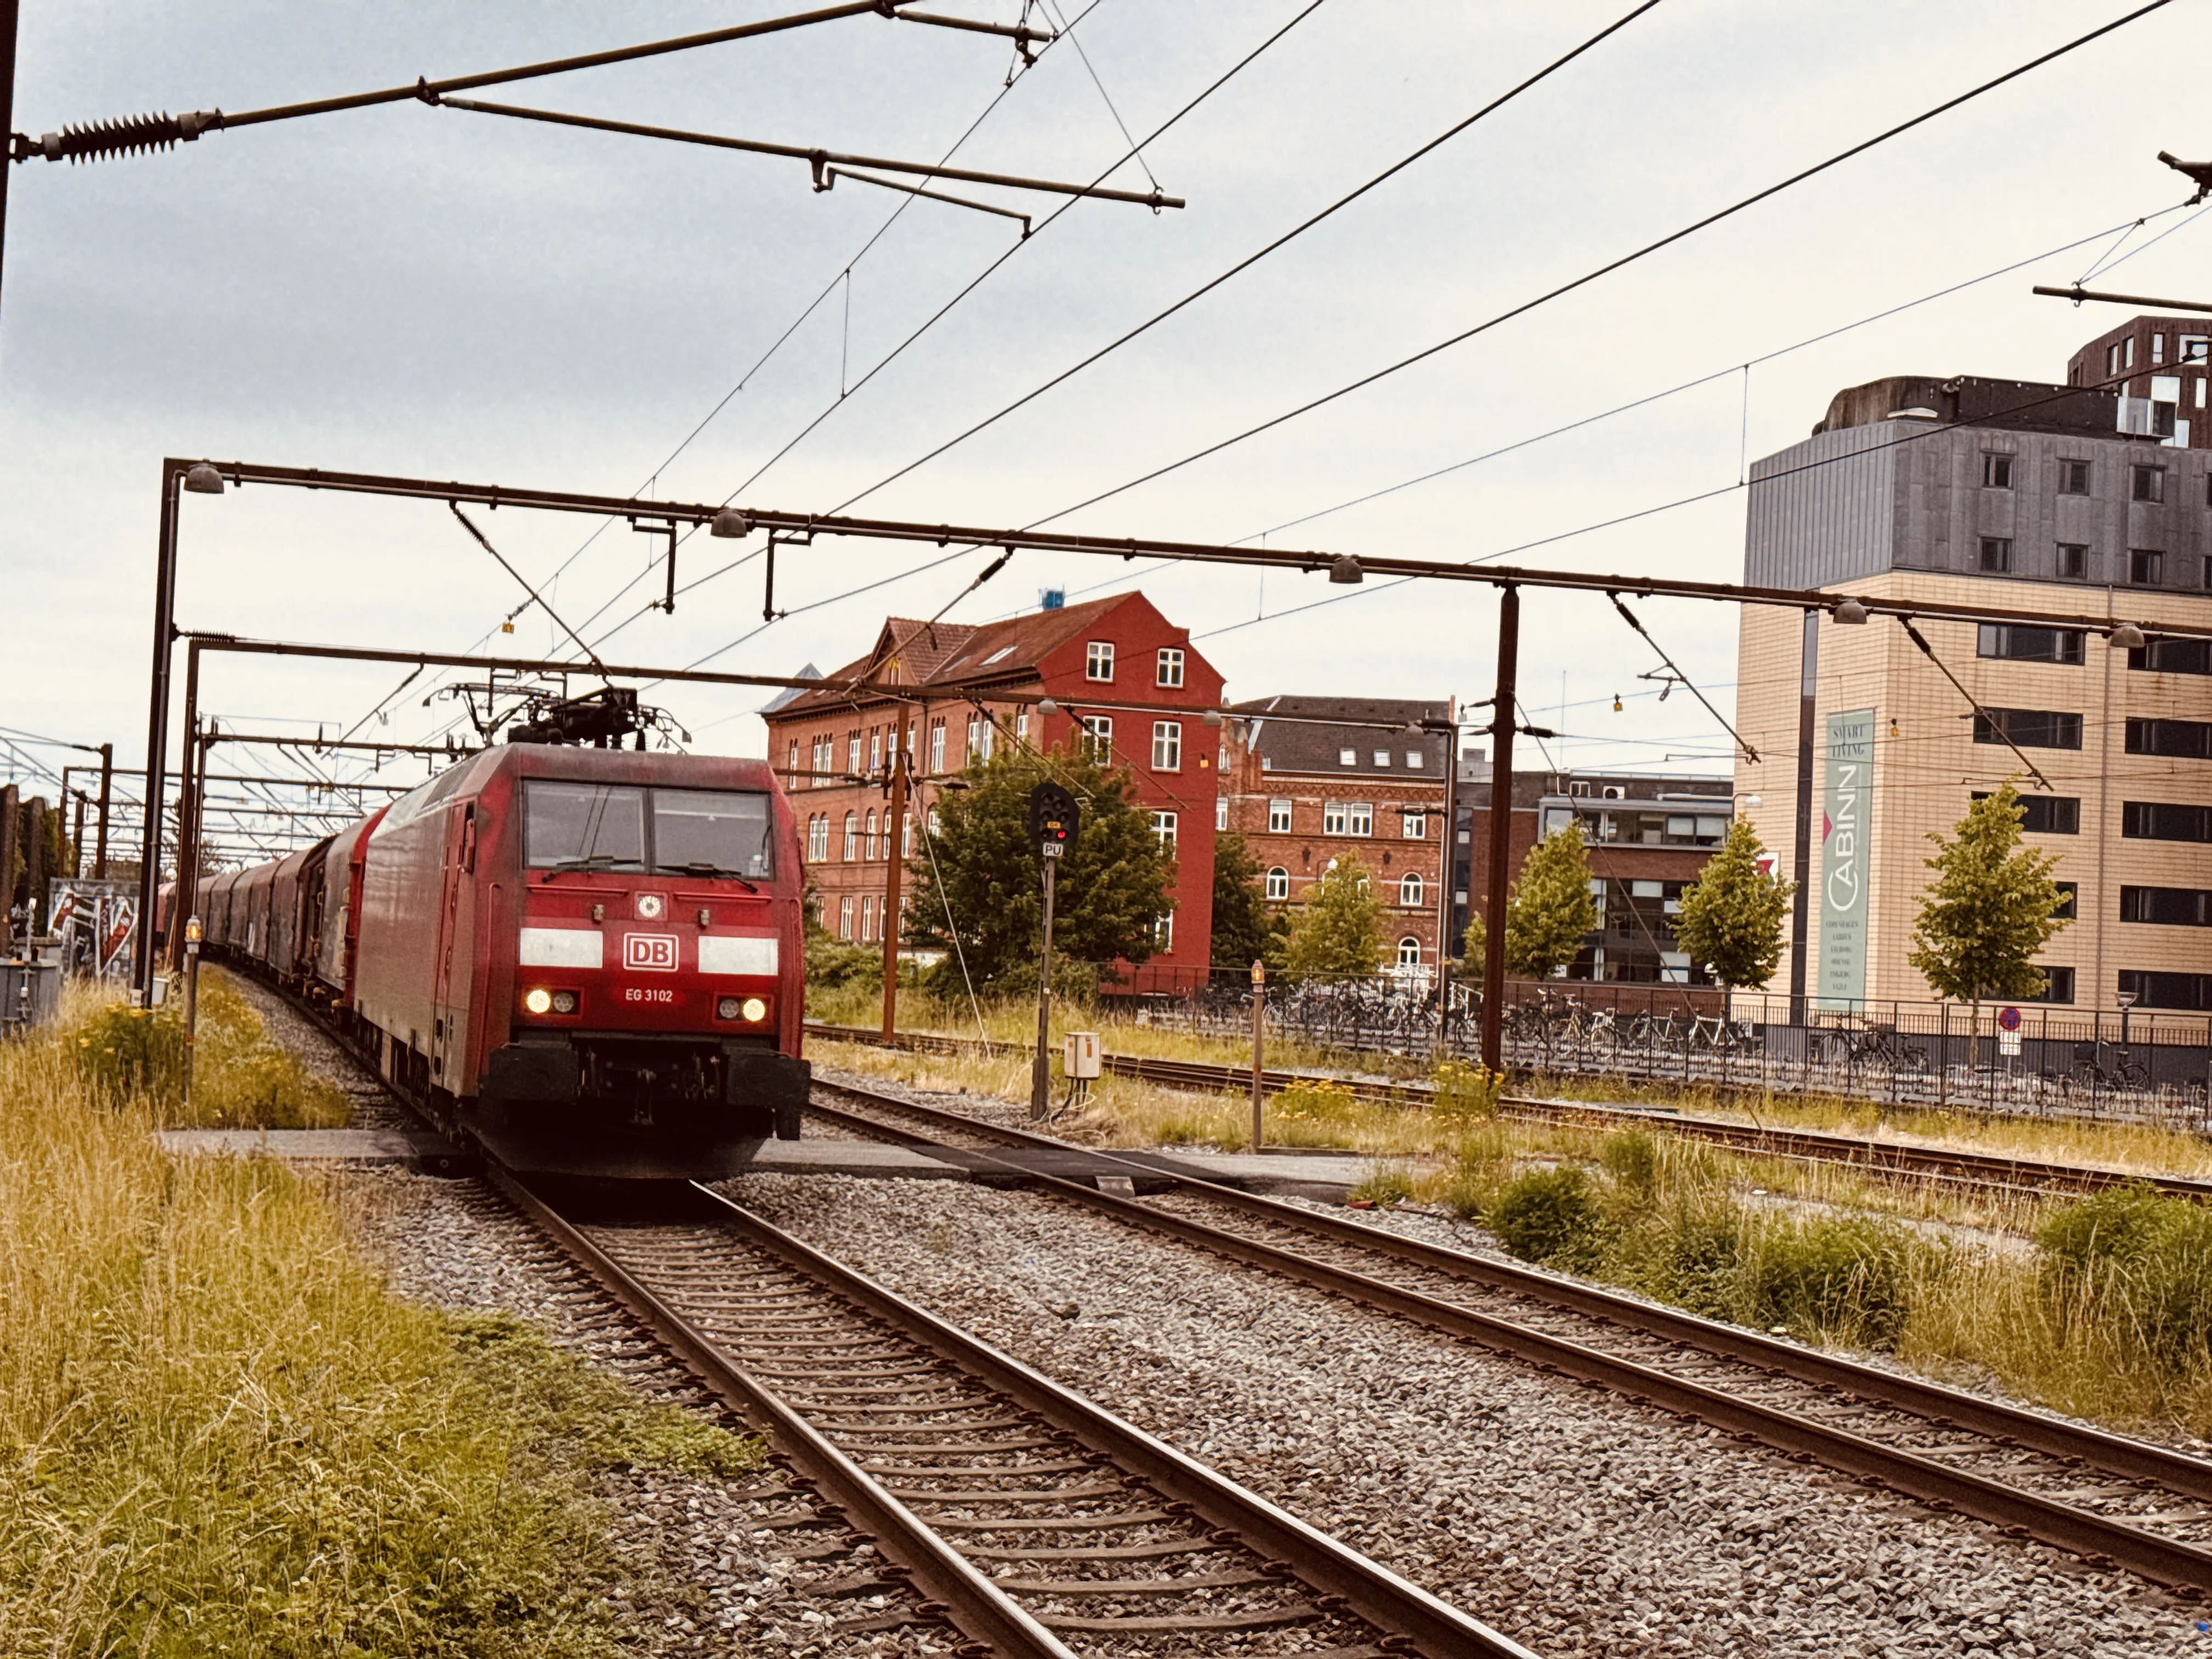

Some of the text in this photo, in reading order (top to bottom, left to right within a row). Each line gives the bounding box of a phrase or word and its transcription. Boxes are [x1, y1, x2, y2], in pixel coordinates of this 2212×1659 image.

[1833, 725, 1864, 738] SMART
[1832, 744, 1865, 758] LIVING
[1828, 764, 1859, 911] CABINN
[1045, 844, 1061, 855] PU
[633, 940, 669, 963] DB
[625, 988, 673, 1002] EG 3102
